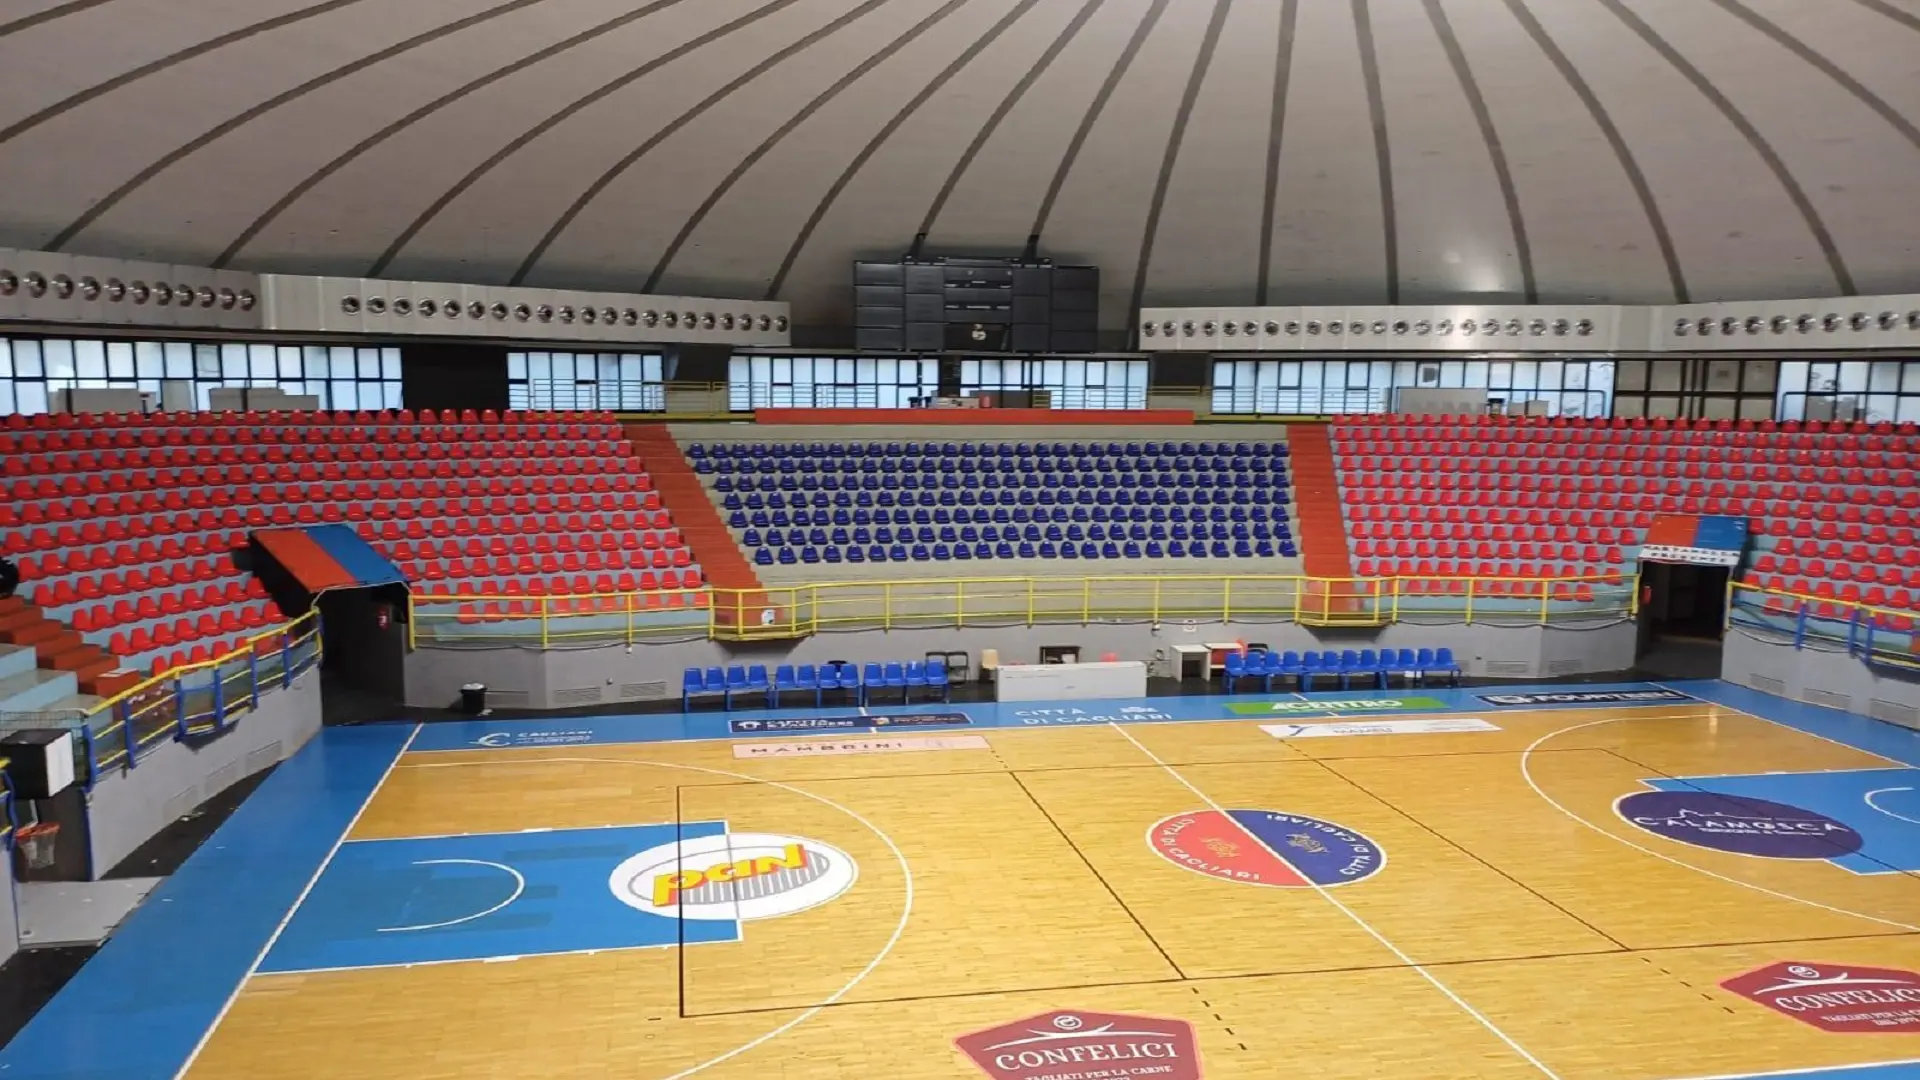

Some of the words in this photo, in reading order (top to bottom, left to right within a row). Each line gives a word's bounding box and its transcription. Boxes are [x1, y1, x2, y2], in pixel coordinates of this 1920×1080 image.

[1023, 717, 1049, 725] DI
[1055, 713, 1173, 723] CAGLIARI
[1266, 814, 1357, 842] CAGLIARI
[1633, 817, 1850, 833] CALAMOSCA
[1169, 847, 1260, 881] CAGLIARI
[994, 1042, 1179, 1072] CONFELICI
[1085, 1071, 1110, 1080] PER
[1111, 1069, 1129, 1077] LA
[1130, 1065, 1174, 1076] CARNE
